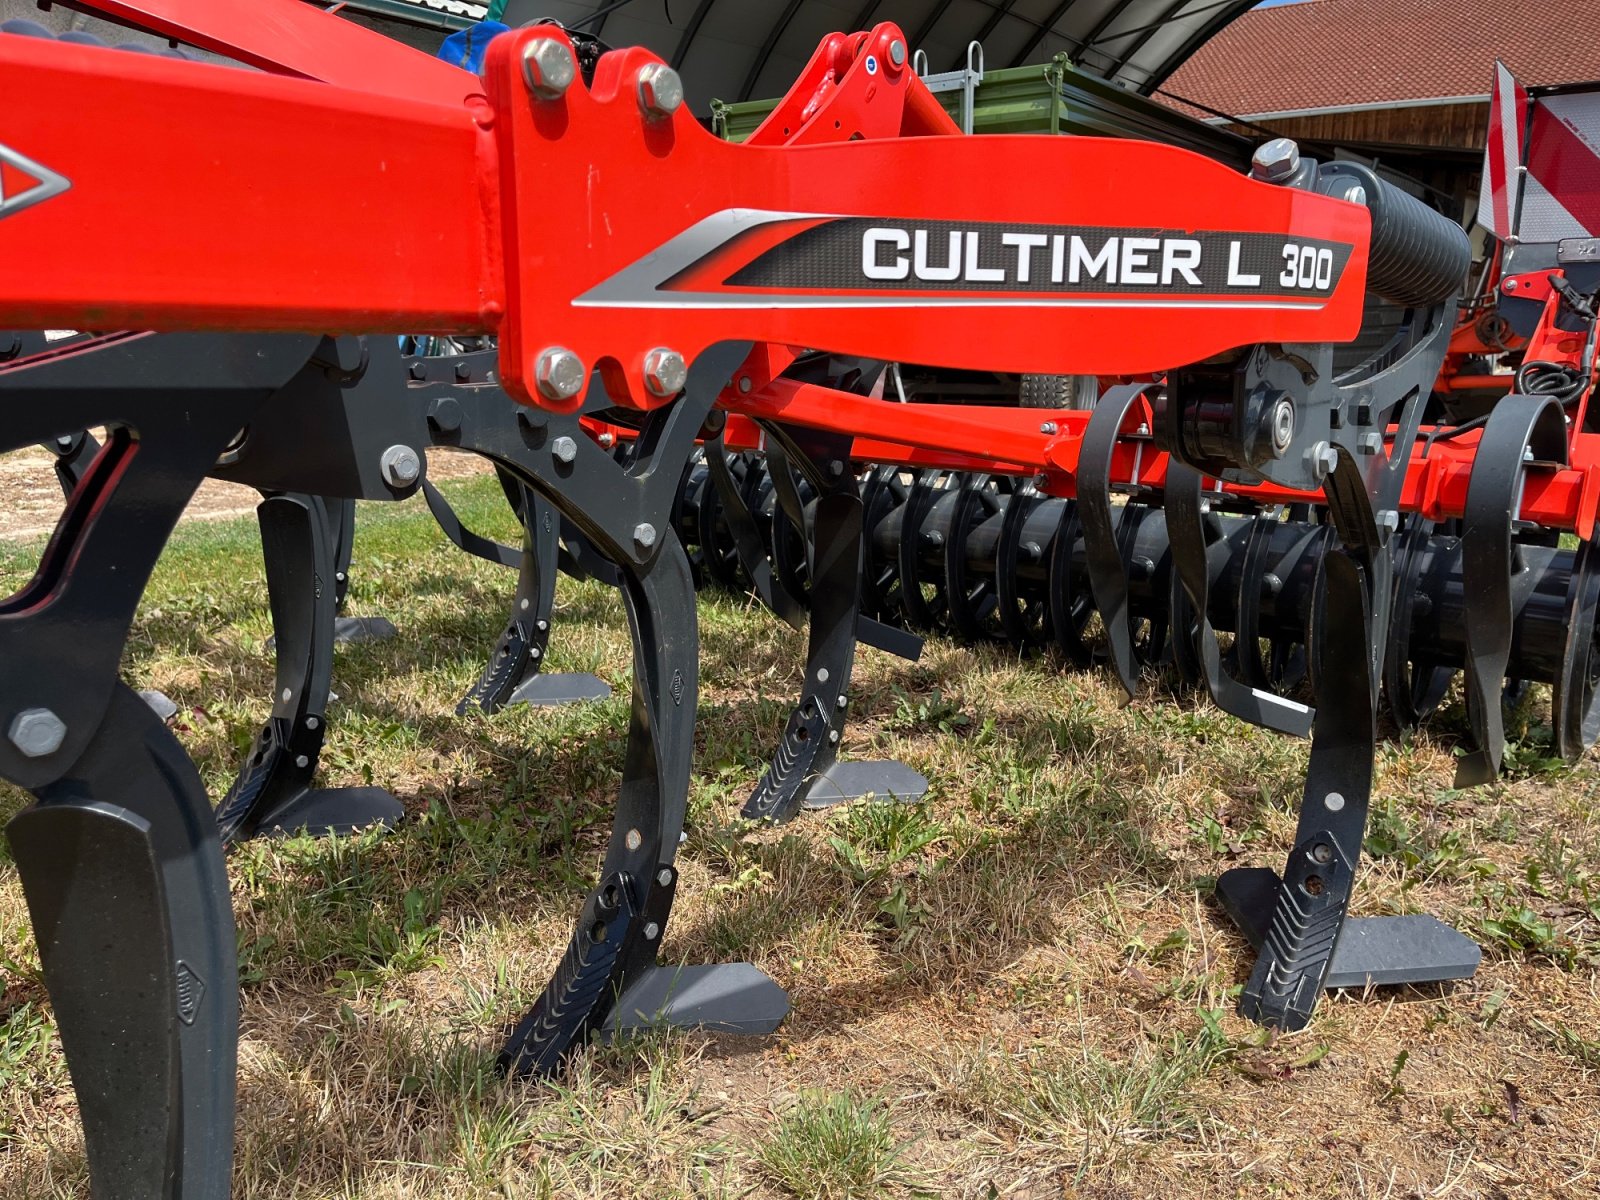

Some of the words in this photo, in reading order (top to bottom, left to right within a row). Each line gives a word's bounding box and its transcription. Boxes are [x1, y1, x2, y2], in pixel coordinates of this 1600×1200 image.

[862, 227, 1203, 285] CULTIMER
[1227, 241, 1261, 286] L
[1280, 243, 1333, 290] 300
